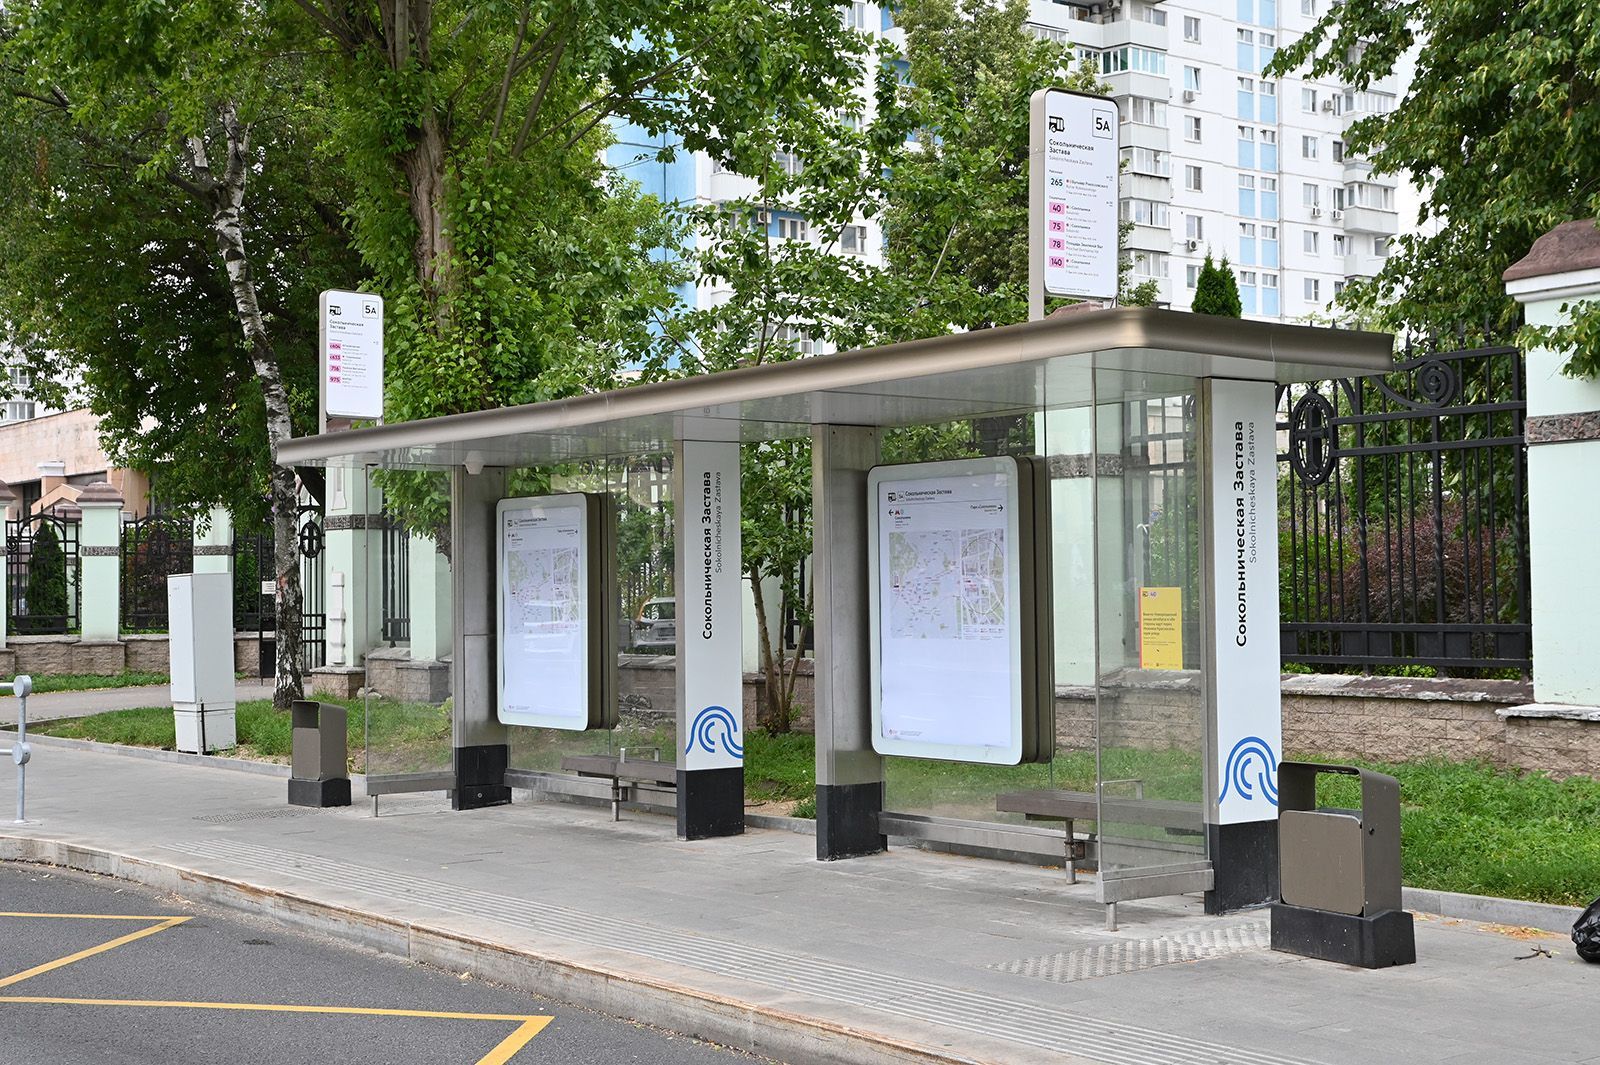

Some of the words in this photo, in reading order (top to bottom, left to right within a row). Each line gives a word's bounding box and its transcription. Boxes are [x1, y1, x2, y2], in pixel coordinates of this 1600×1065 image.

[1048, 138, 1095, 152] Сокольническая
[1048, 146, 1071, 156] Застава
[1050, 177, 1063, 187] 265
[1052, 204, 1062, 213] 40
[1052, 222, 1062, 231] 75
[1052, 240, 1062, 249] 78
[1051, 258, 1063, 267] 140
[1233, 421, 1245, 491] Застава
[1247, 422, 1256, 465] Zastava
[702, 471, 712, 524] Застава
[714, 471, 722, 503] Zastava
[1248, 469, 1257, 564] Sokolnicheskaya
[714, 505, 723, 573] Sokolnicheskaya
[702, 528, 713, 640] Сокольническая
[1235, 497, 1247, 647] Сокольническая
